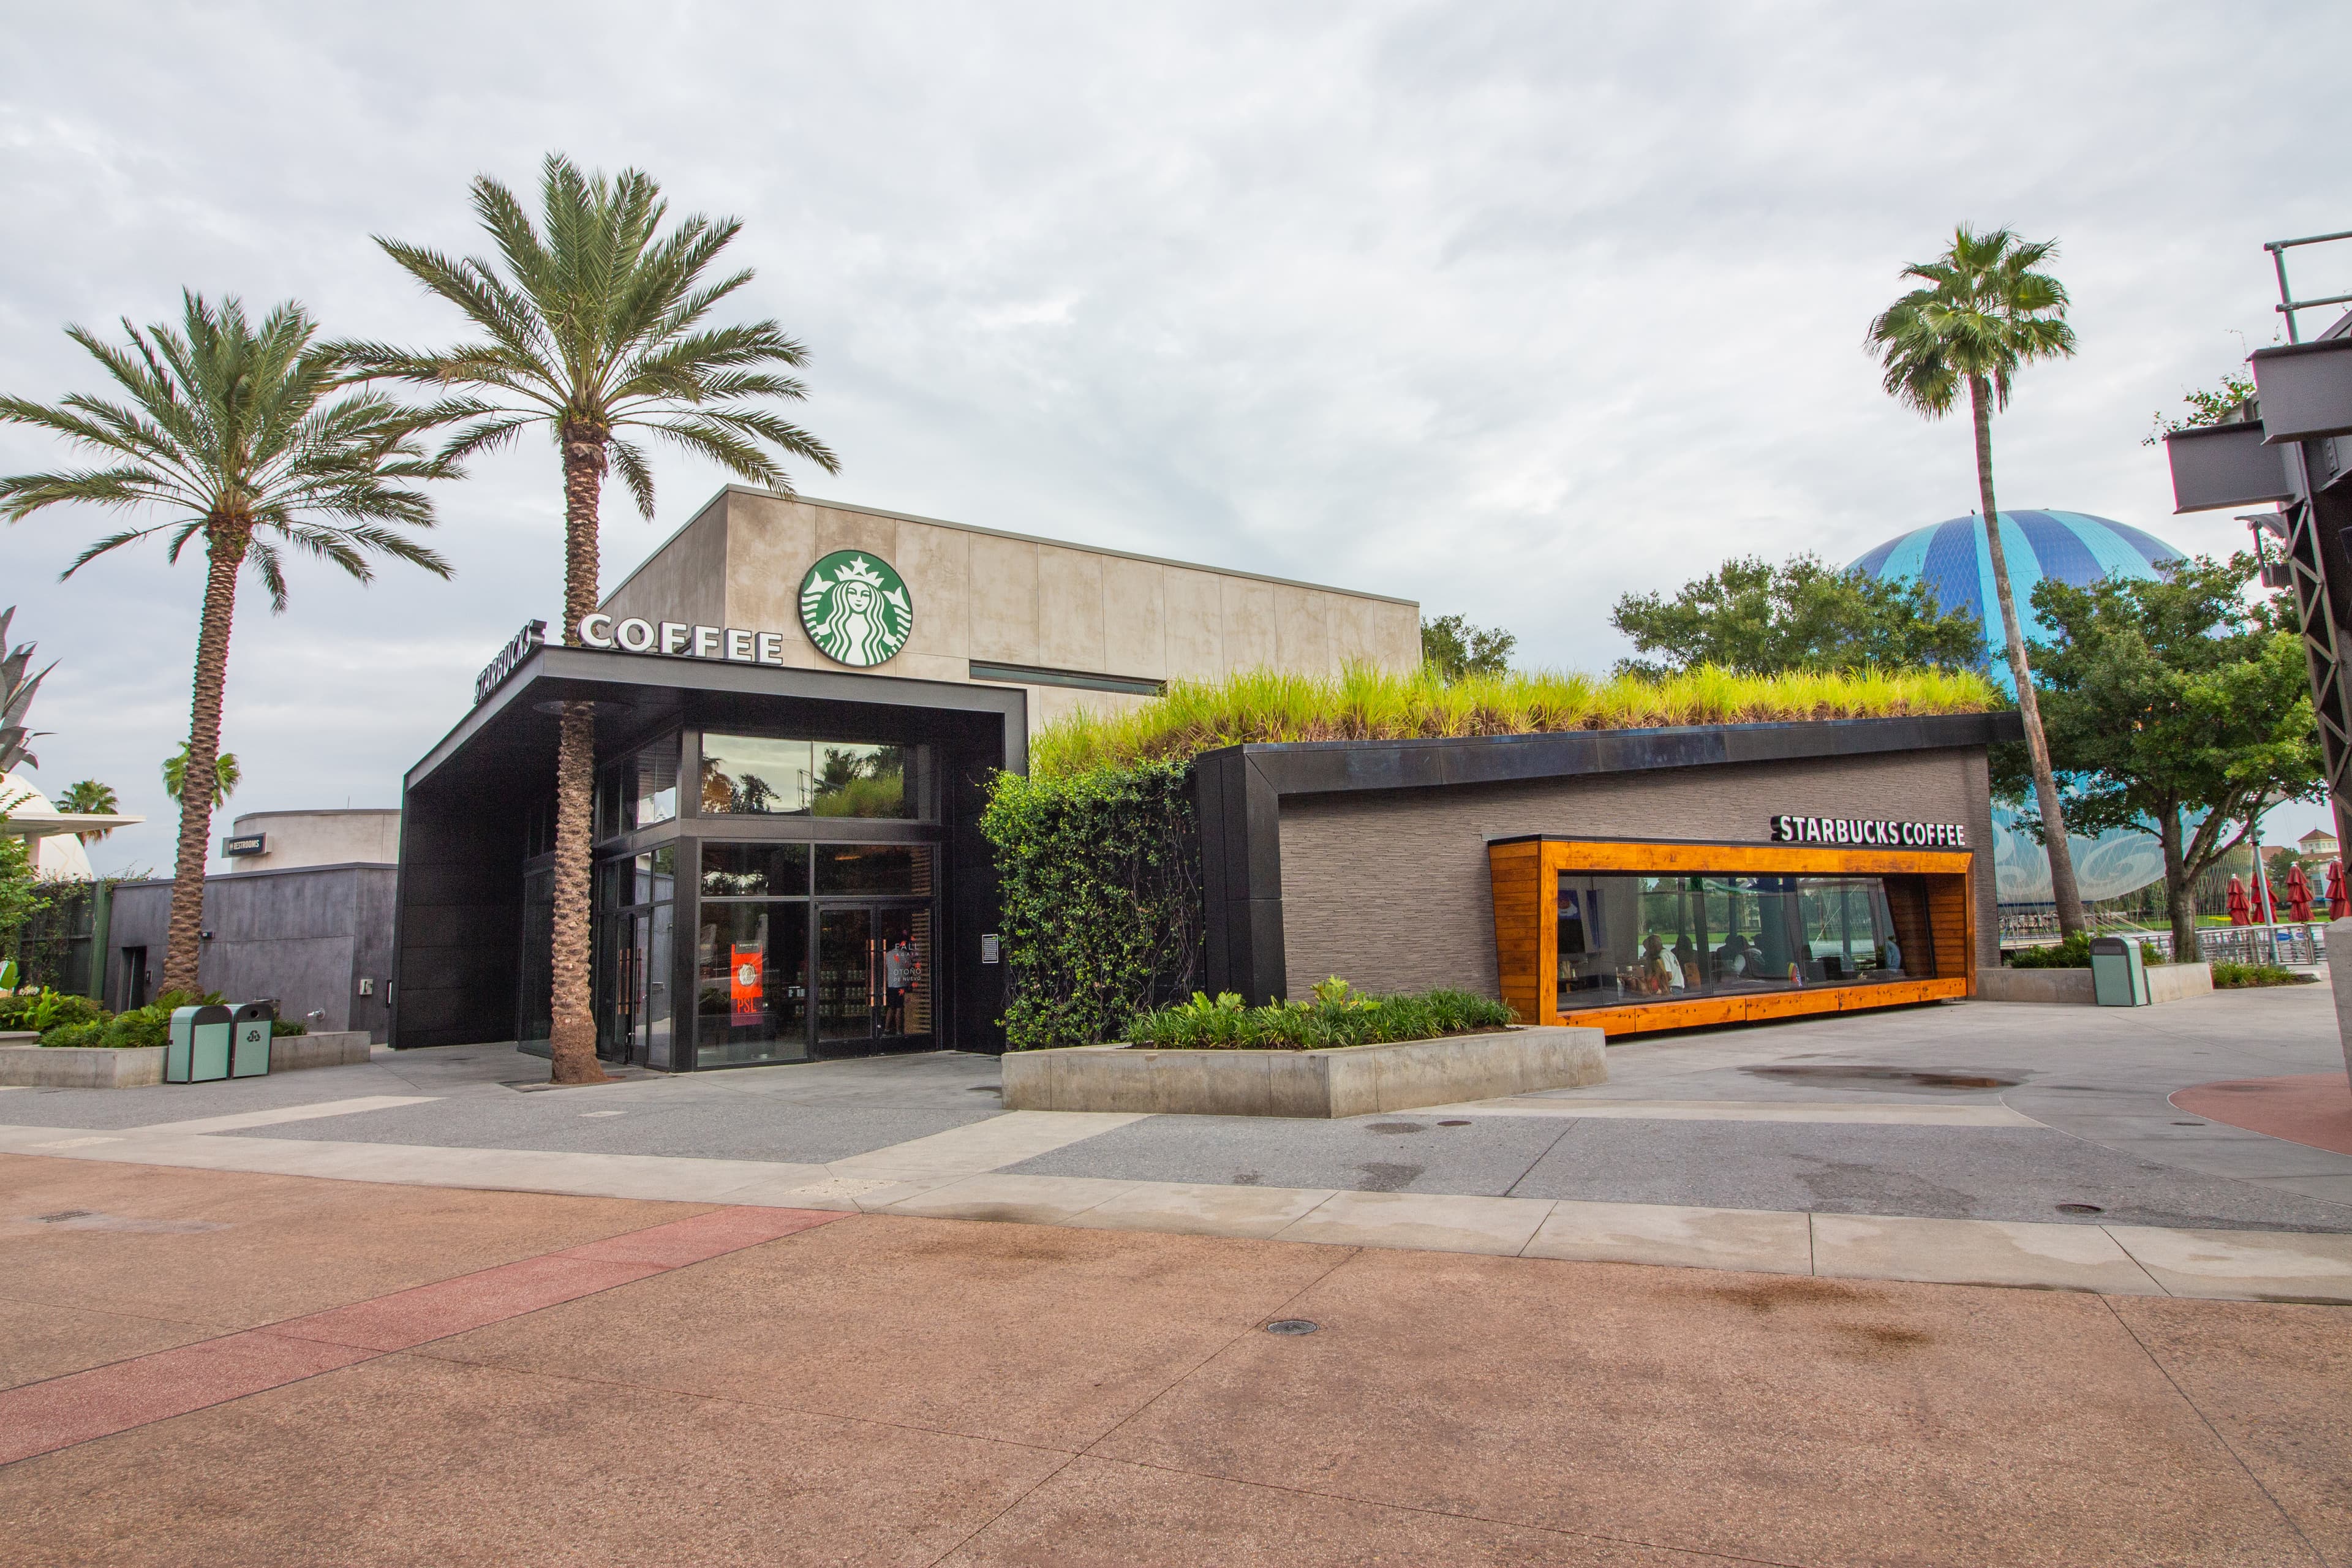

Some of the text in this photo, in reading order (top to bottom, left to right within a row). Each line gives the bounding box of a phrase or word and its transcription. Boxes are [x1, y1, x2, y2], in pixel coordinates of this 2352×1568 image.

[577, 614, 783, 665] COFFEE
[474, 619, 540, 704] STARBUCKS
[1774, 815, 1966, 846] STARBUCKS COFFEE
[233, 840, 260, 850] RESTROOMS
[895, 942, 920, 951] FALL
[737, 997, 757, 1014] PSL
